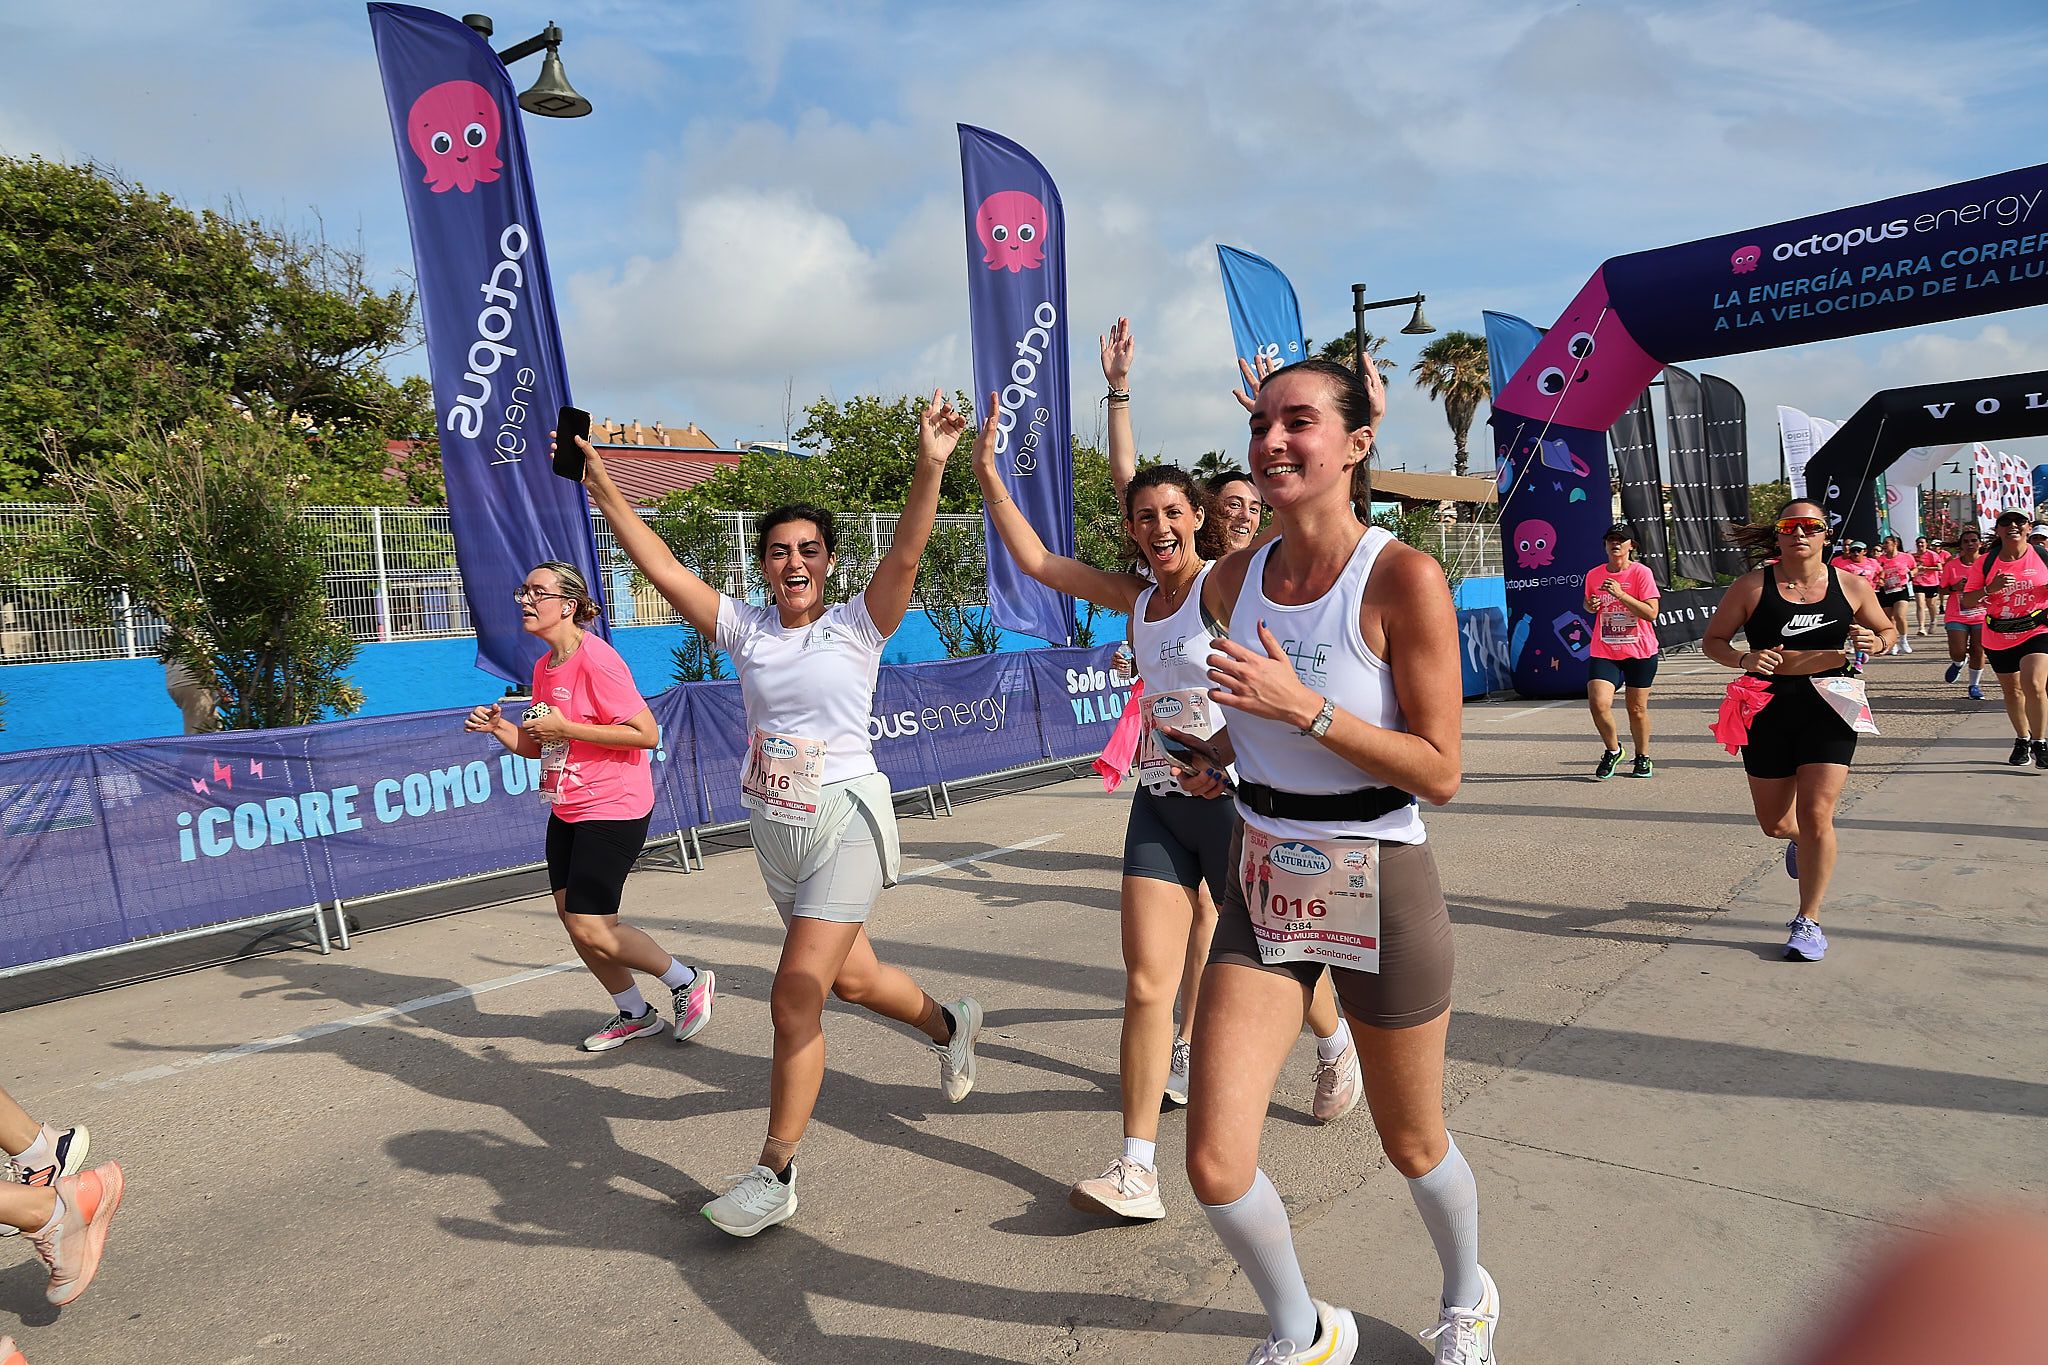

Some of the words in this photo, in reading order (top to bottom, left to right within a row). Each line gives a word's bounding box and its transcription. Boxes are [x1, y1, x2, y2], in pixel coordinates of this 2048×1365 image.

[1772, 219, 1909, 262] octopus
[1913, 189, 2043, 233] energy
[1713, 290, 1742, 310] LA
[1748, 267, 1853, 304] ENERGÍA
[1860, 255, 1932, 284] PARA
[1714, 316, 1730, 332] A
[1736, 310, 1765, 328] LA
[1771, 285, 1914, 322] VELOCIDAD
[1922, 276, 1958, 297] DE
[1965, 269, 2000, 290] LA
[2009, 260, 2048, 282] LU
[1540, 574, 1585, 588] energy
[1789, 613, 1825, 627] NIKE
[1066, 665, 1106, 694] Solo
[921, 694, 1006, 732] energy
[1070, 697, 1097, 725] YA
[1097, 692, 1122, 721] LO
[178, 784, 363, 863] ¡CORRE
[373, 760, 491, 824] COMO
[1273, 850, 1326, 870] ASTURIANA
[1271, 894, 1327, 919] 016
[1271, 932, 1281, 940] DE
[1282, 932, 1293, 941] LA
[1294, 931, 1320, 940] MUJER
[1326, 933, 1362, 945] VALENCIA
[1284, 921, 1313, 932] 4384
[1259, 944, 1286, 957] SHO
[1316, 947, 1362, 963] Santander
